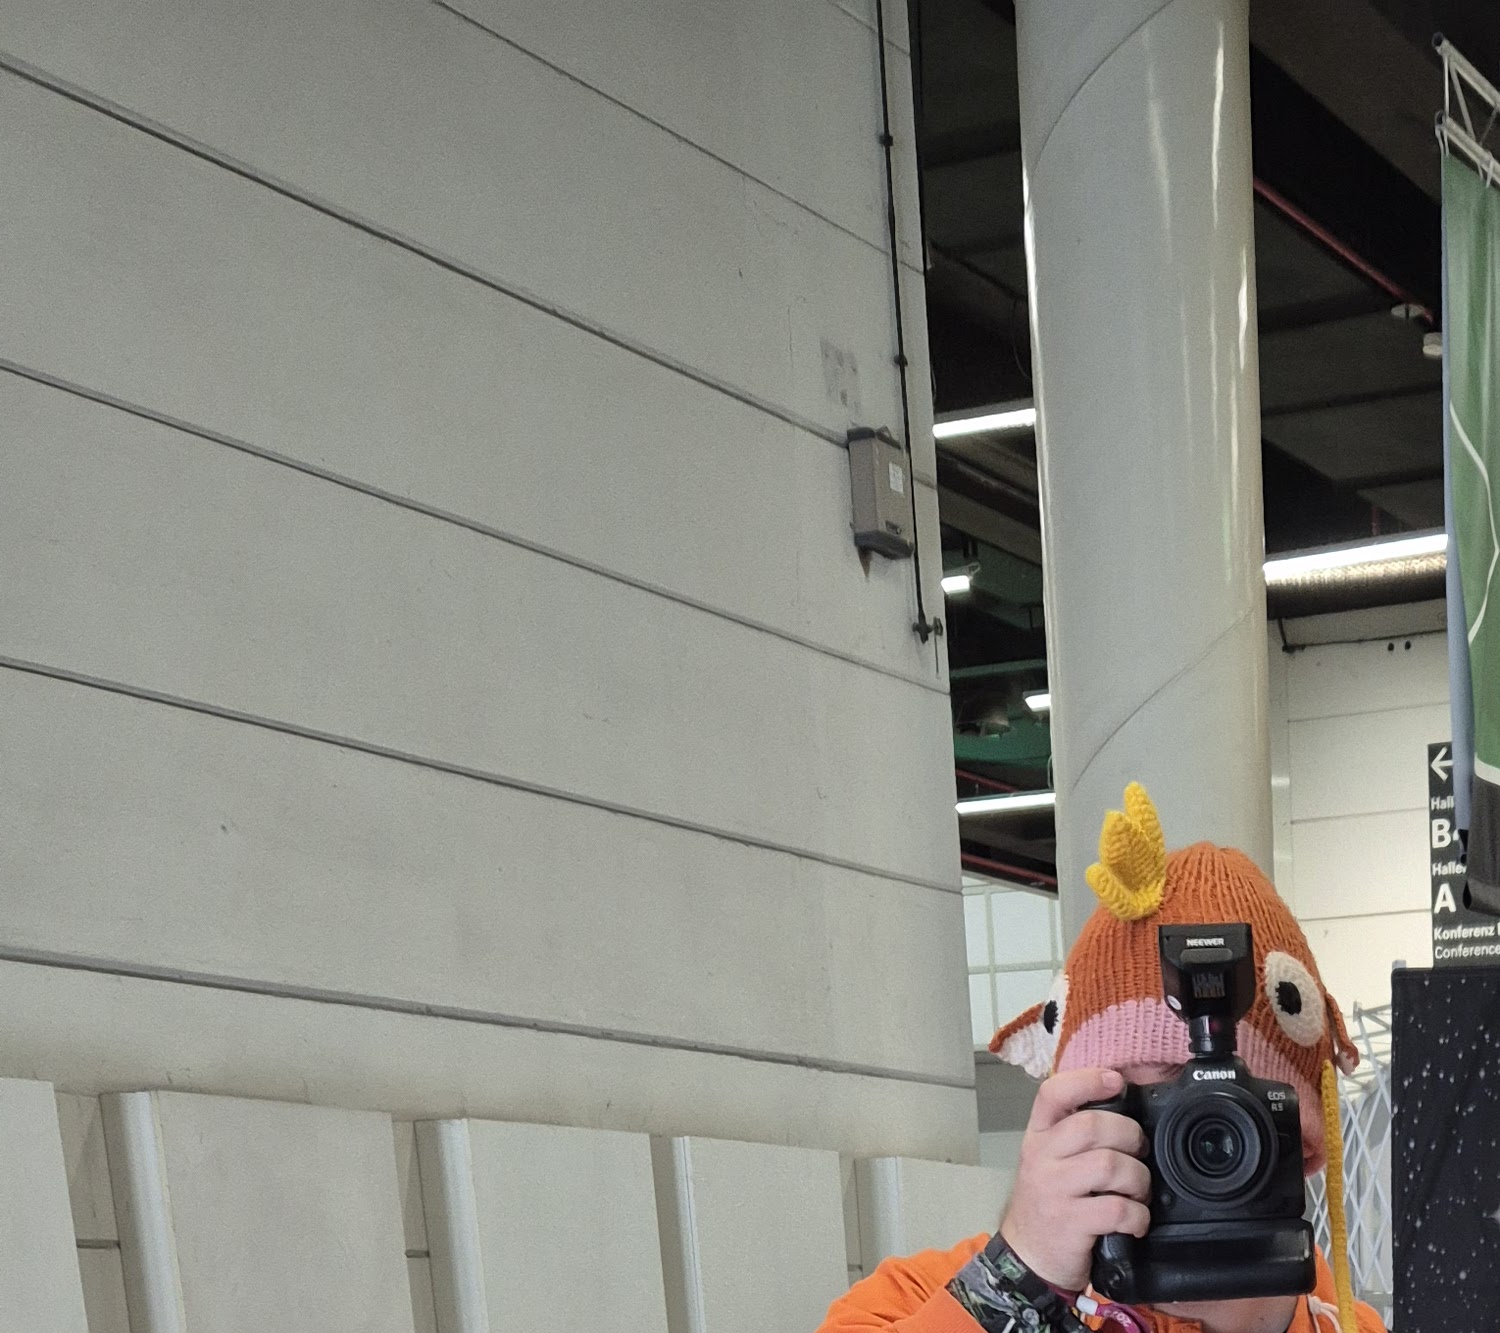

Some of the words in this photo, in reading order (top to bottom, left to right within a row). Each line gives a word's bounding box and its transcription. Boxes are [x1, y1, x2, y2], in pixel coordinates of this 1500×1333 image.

[1434, 883, 1457, 913] A
[1434, 923, 1494, 941] Konferenz
[1186, 938, 1225, 947] NEEWER
[1192, 1069, 1236, 1081] Canon
[1267, 1091, 1286, 1101] EOS
